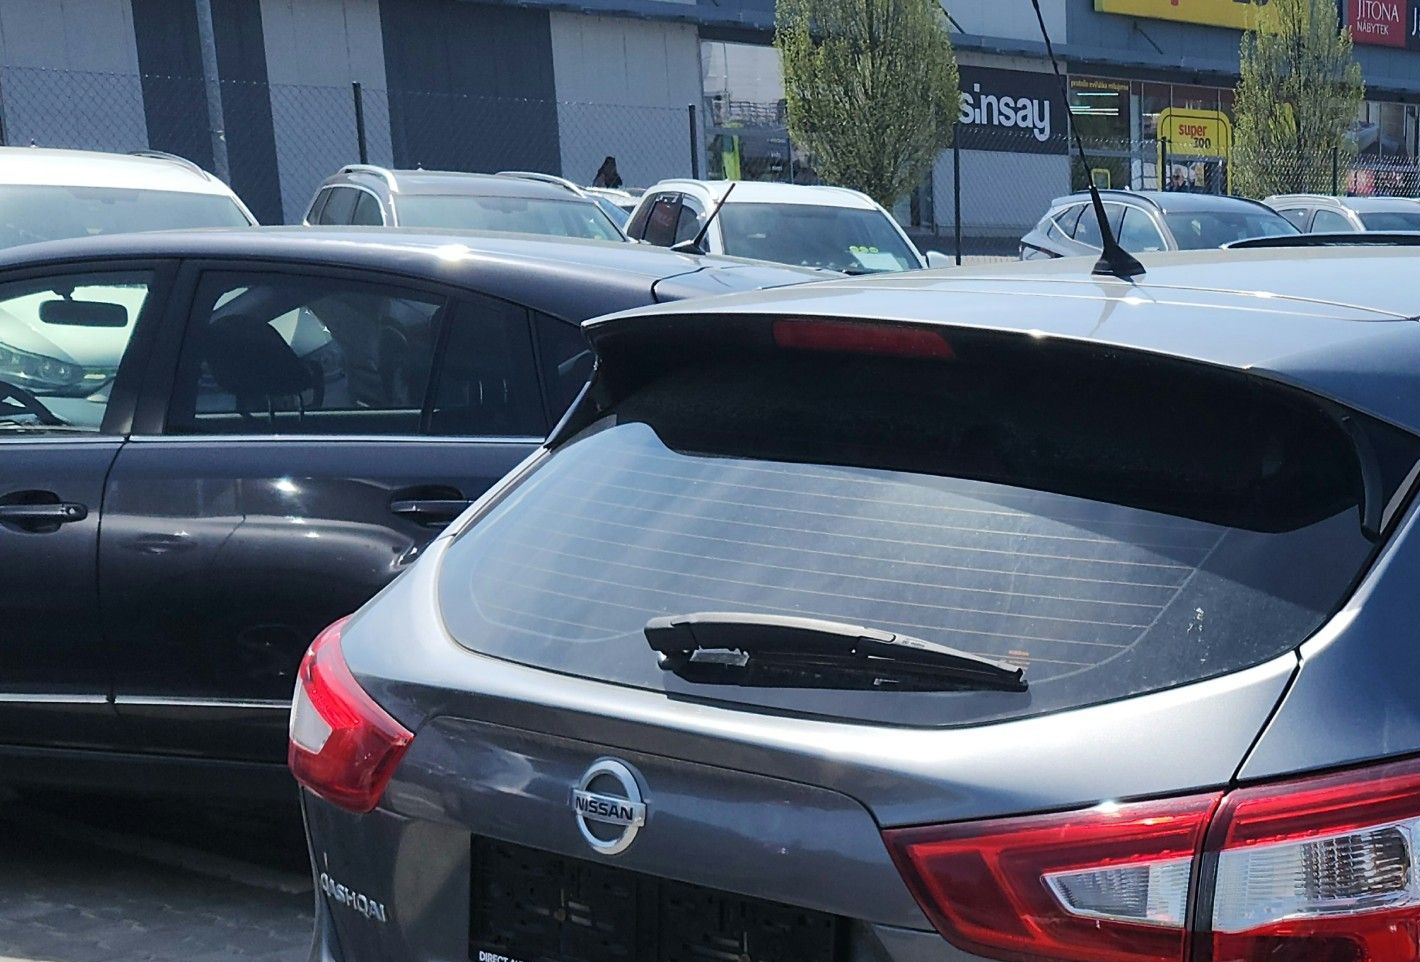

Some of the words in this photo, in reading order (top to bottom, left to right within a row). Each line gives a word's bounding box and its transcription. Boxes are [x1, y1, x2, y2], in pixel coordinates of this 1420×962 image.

[1356, 0, 1399, 22] JITONA
[958, 83, 1051, 142] sinsay
[1178, 124, 1207, 138] super
[575, 796, 634, 821] NISSAN
[320, 872, 386, 922] QASHQAI
